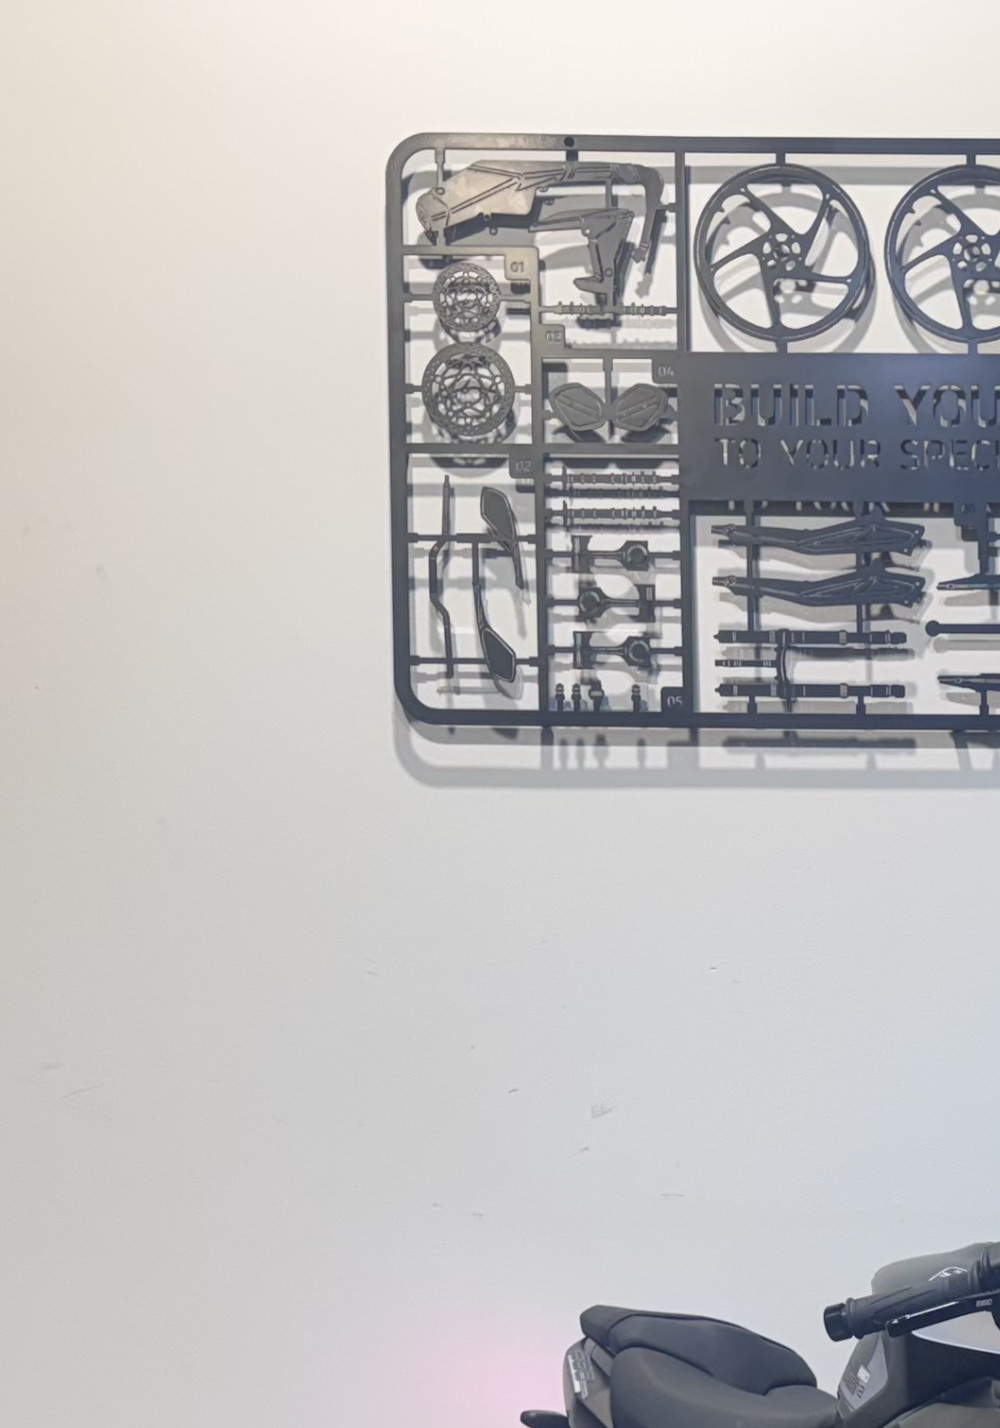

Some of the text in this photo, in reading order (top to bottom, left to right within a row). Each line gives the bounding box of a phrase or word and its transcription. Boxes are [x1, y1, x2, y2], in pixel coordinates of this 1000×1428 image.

[510, 261, 524, 272] 01
[658, 366, 674, 376] 04
[713, 383, 869, 427] BUILD
[714, 438, 763, 469] TO
[780, 439, 882, 470] YOUR
[515, 461, 531, 472] 02
[667, 696, 683, 707] 05
